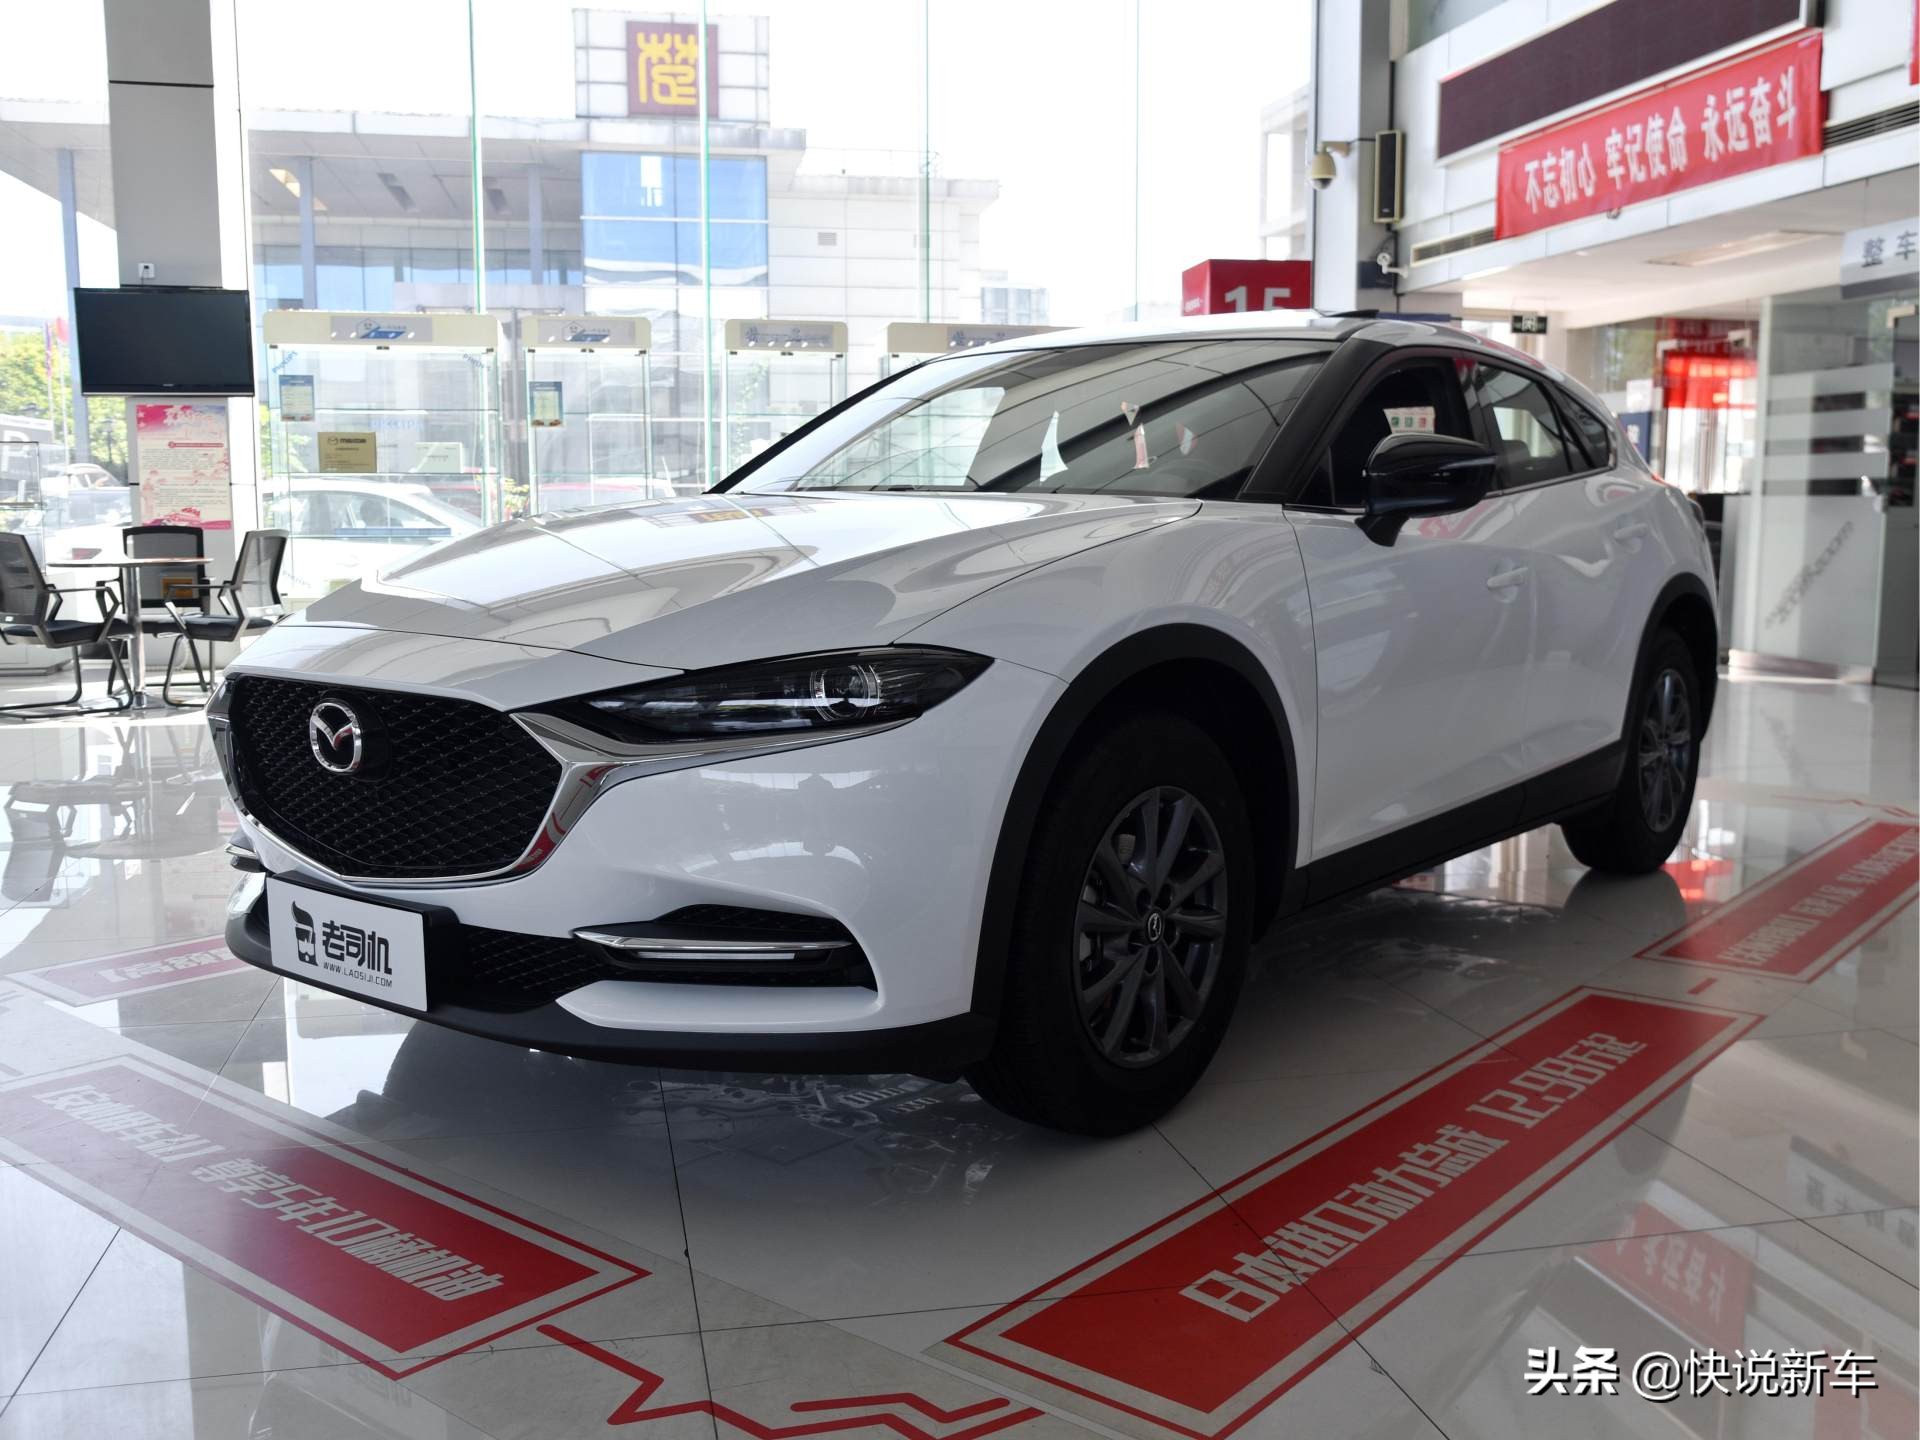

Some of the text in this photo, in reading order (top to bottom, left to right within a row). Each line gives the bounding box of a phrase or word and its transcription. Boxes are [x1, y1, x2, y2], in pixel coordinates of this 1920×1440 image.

[1524, 65, 1797, 214] 不忘初心 牢记使命 永远奋斗
[322, 920, 393, 976] 老司机
[323, 961, 393, 989] WWW.LAOSIJI.COM
[191, 1158, 505, 1301] 尊享5年10桶机油
[1179, 1032, 1648, 1323] 日本进口动力总成 12.98万起
